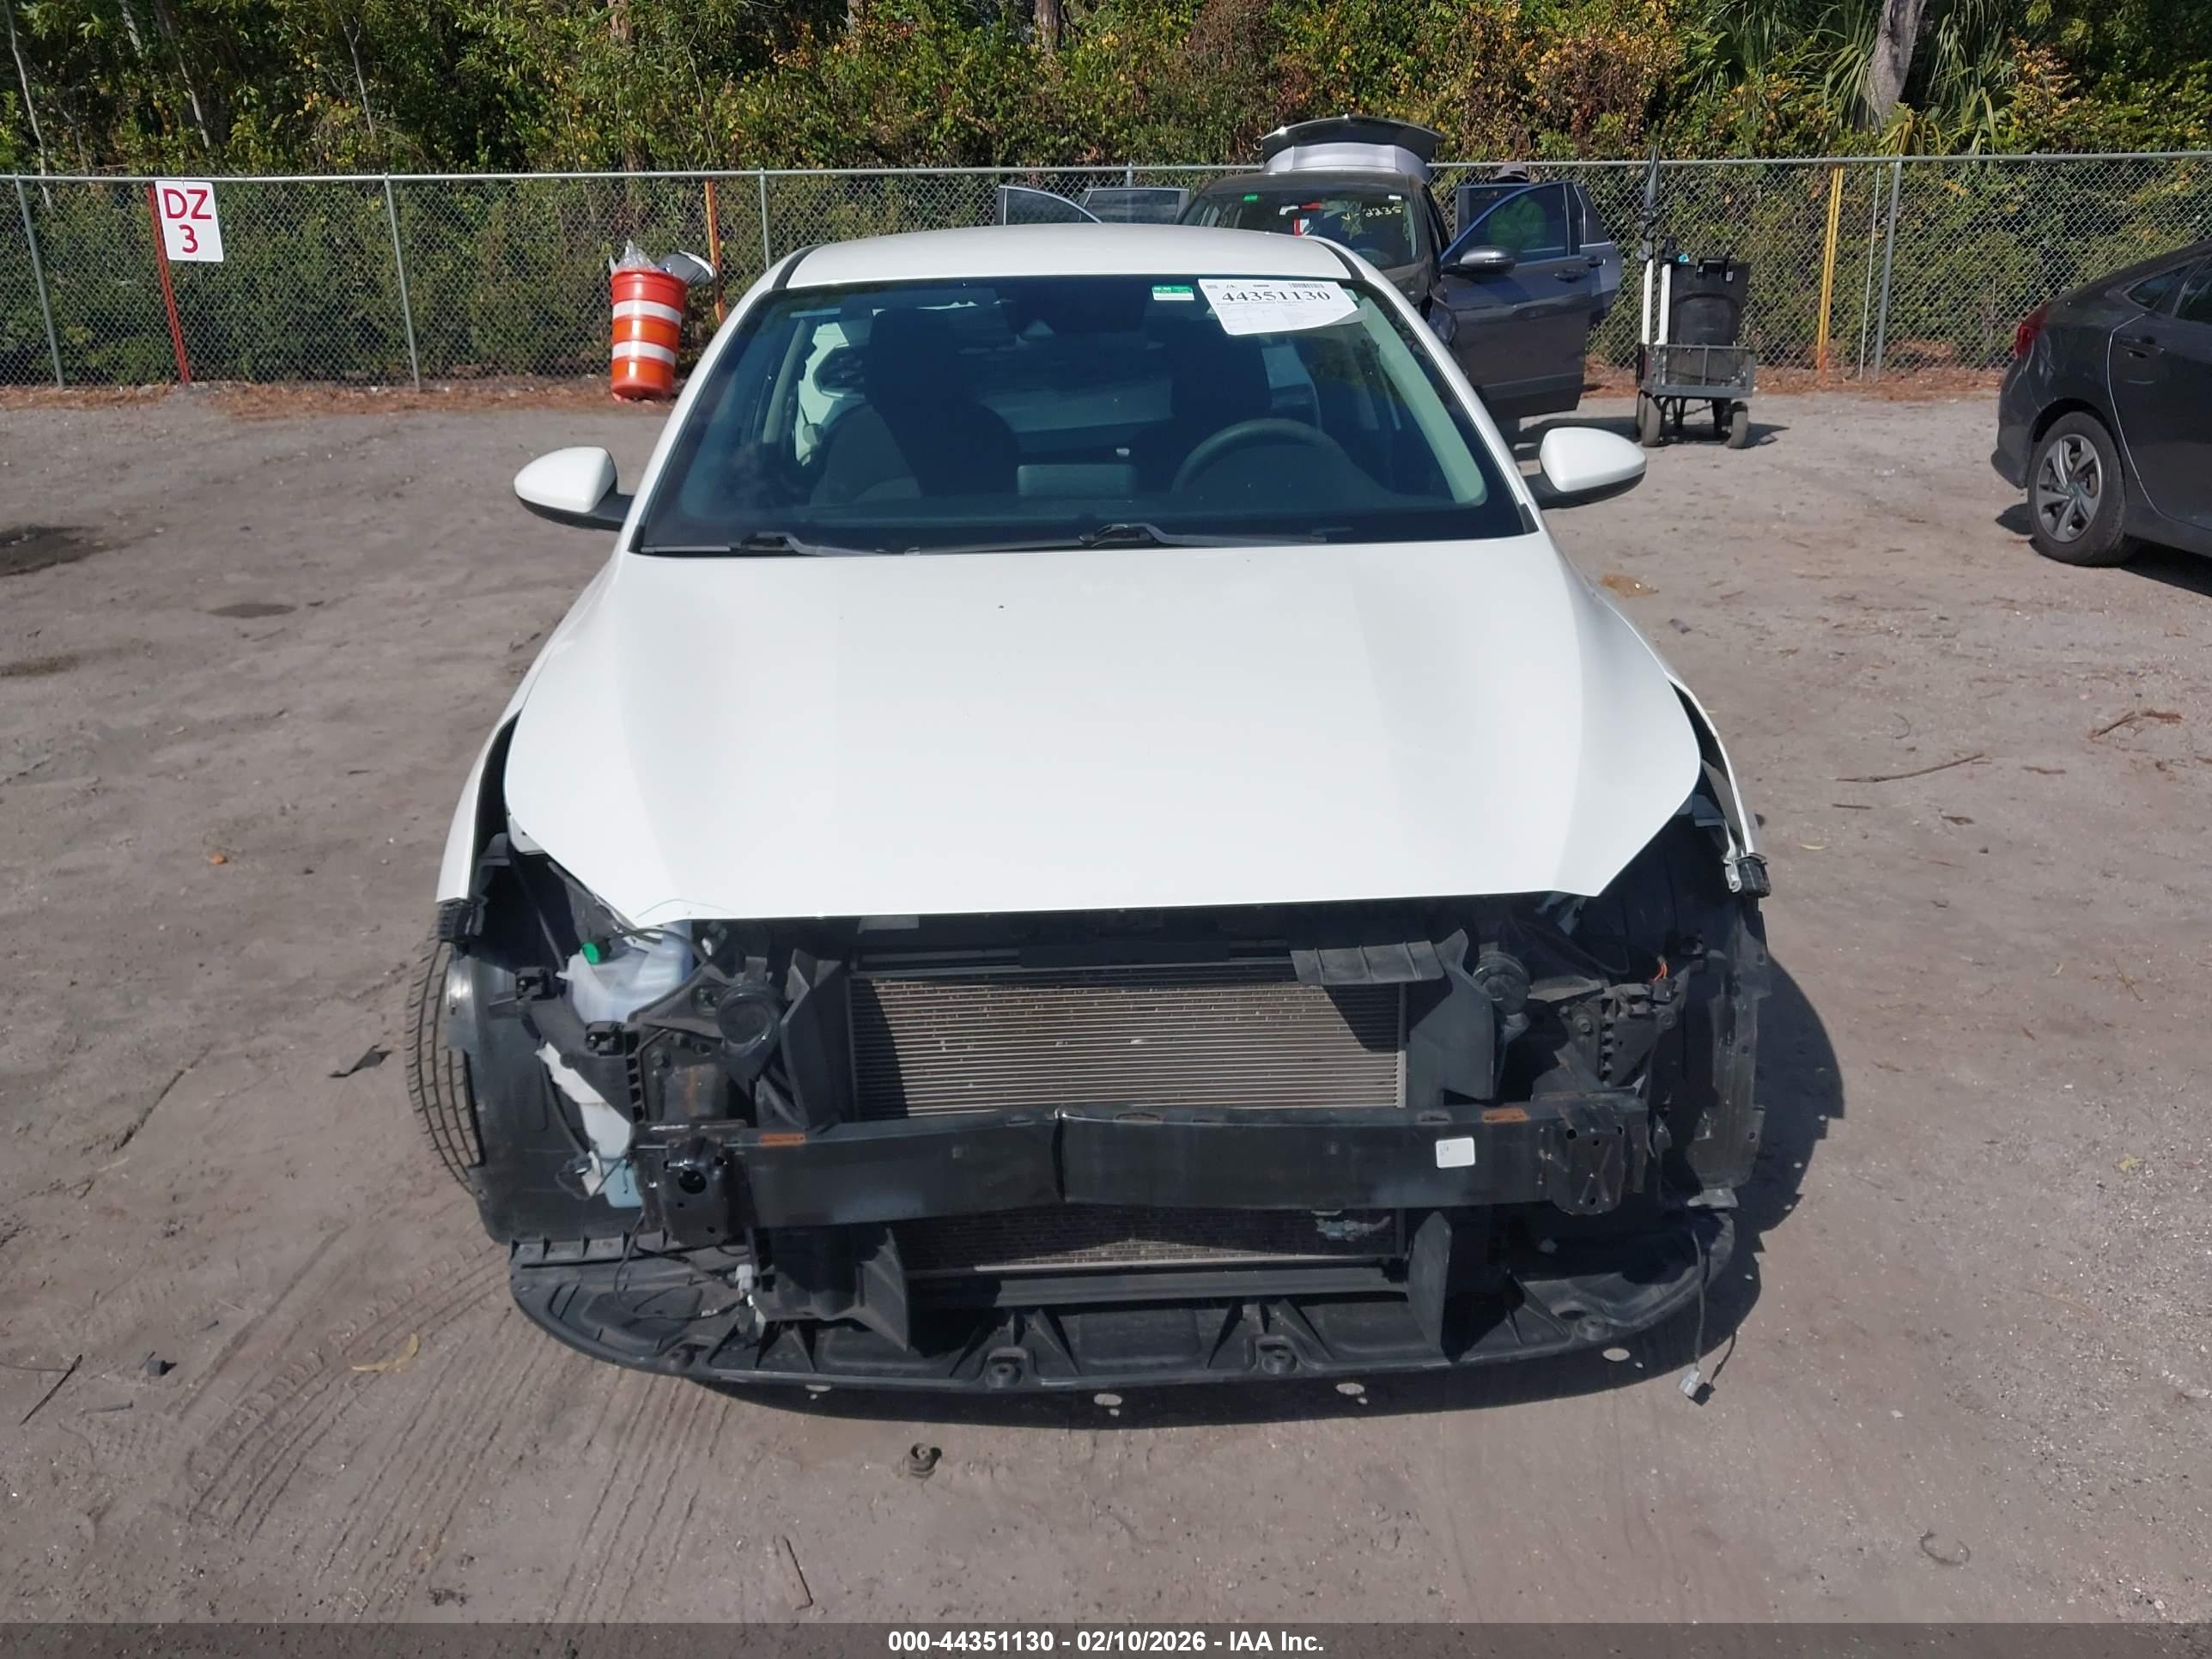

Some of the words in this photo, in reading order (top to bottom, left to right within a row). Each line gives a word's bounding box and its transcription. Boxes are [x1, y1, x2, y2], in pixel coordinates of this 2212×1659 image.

[162, 188, 213, 221] DZ
[178, 223, 199, 254] 3
[1222, 290, 1331, 301] 44351130
